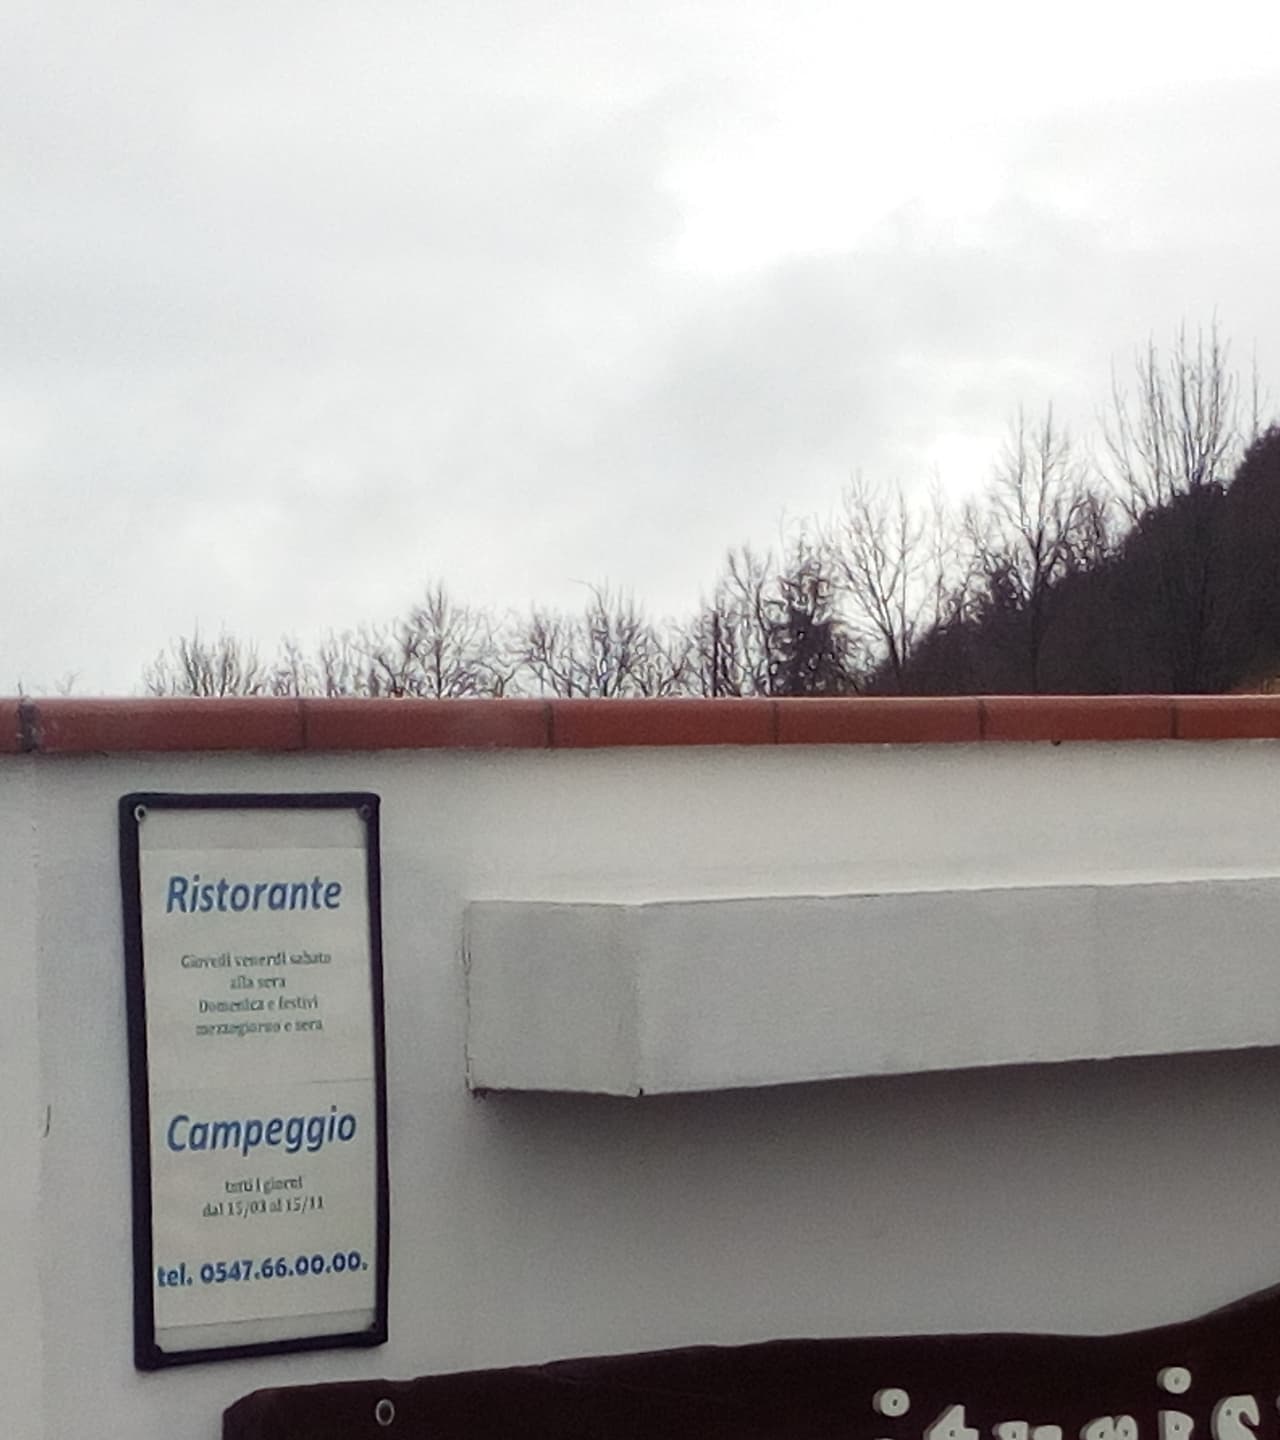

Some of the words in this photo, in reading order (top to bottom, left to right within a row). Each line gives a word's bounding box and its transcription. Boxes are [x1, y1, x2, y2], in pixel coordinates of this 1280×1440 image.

[166, 874, 342, 913] Ristorante
[230, 975, 253, 989] alla
[257, 977, 286, 989] sera
[199, 997, 264, 1013] Domenica
[279, 994, 318, 1010] festivi
[284, 1021, 292, 1032] e
[295, 1019, 323, 1032] sera
[167, 1104, 357, 1157] Campeggio
[202, 1202, 223, 1217] dal
[269, 1198, 282, 1213] al
[287, 1195, 323, 1214] 15/11
[157, 1263, 193, 1287] tel.
[200, 1251, 368, 1284] 0547.66.00.00.
